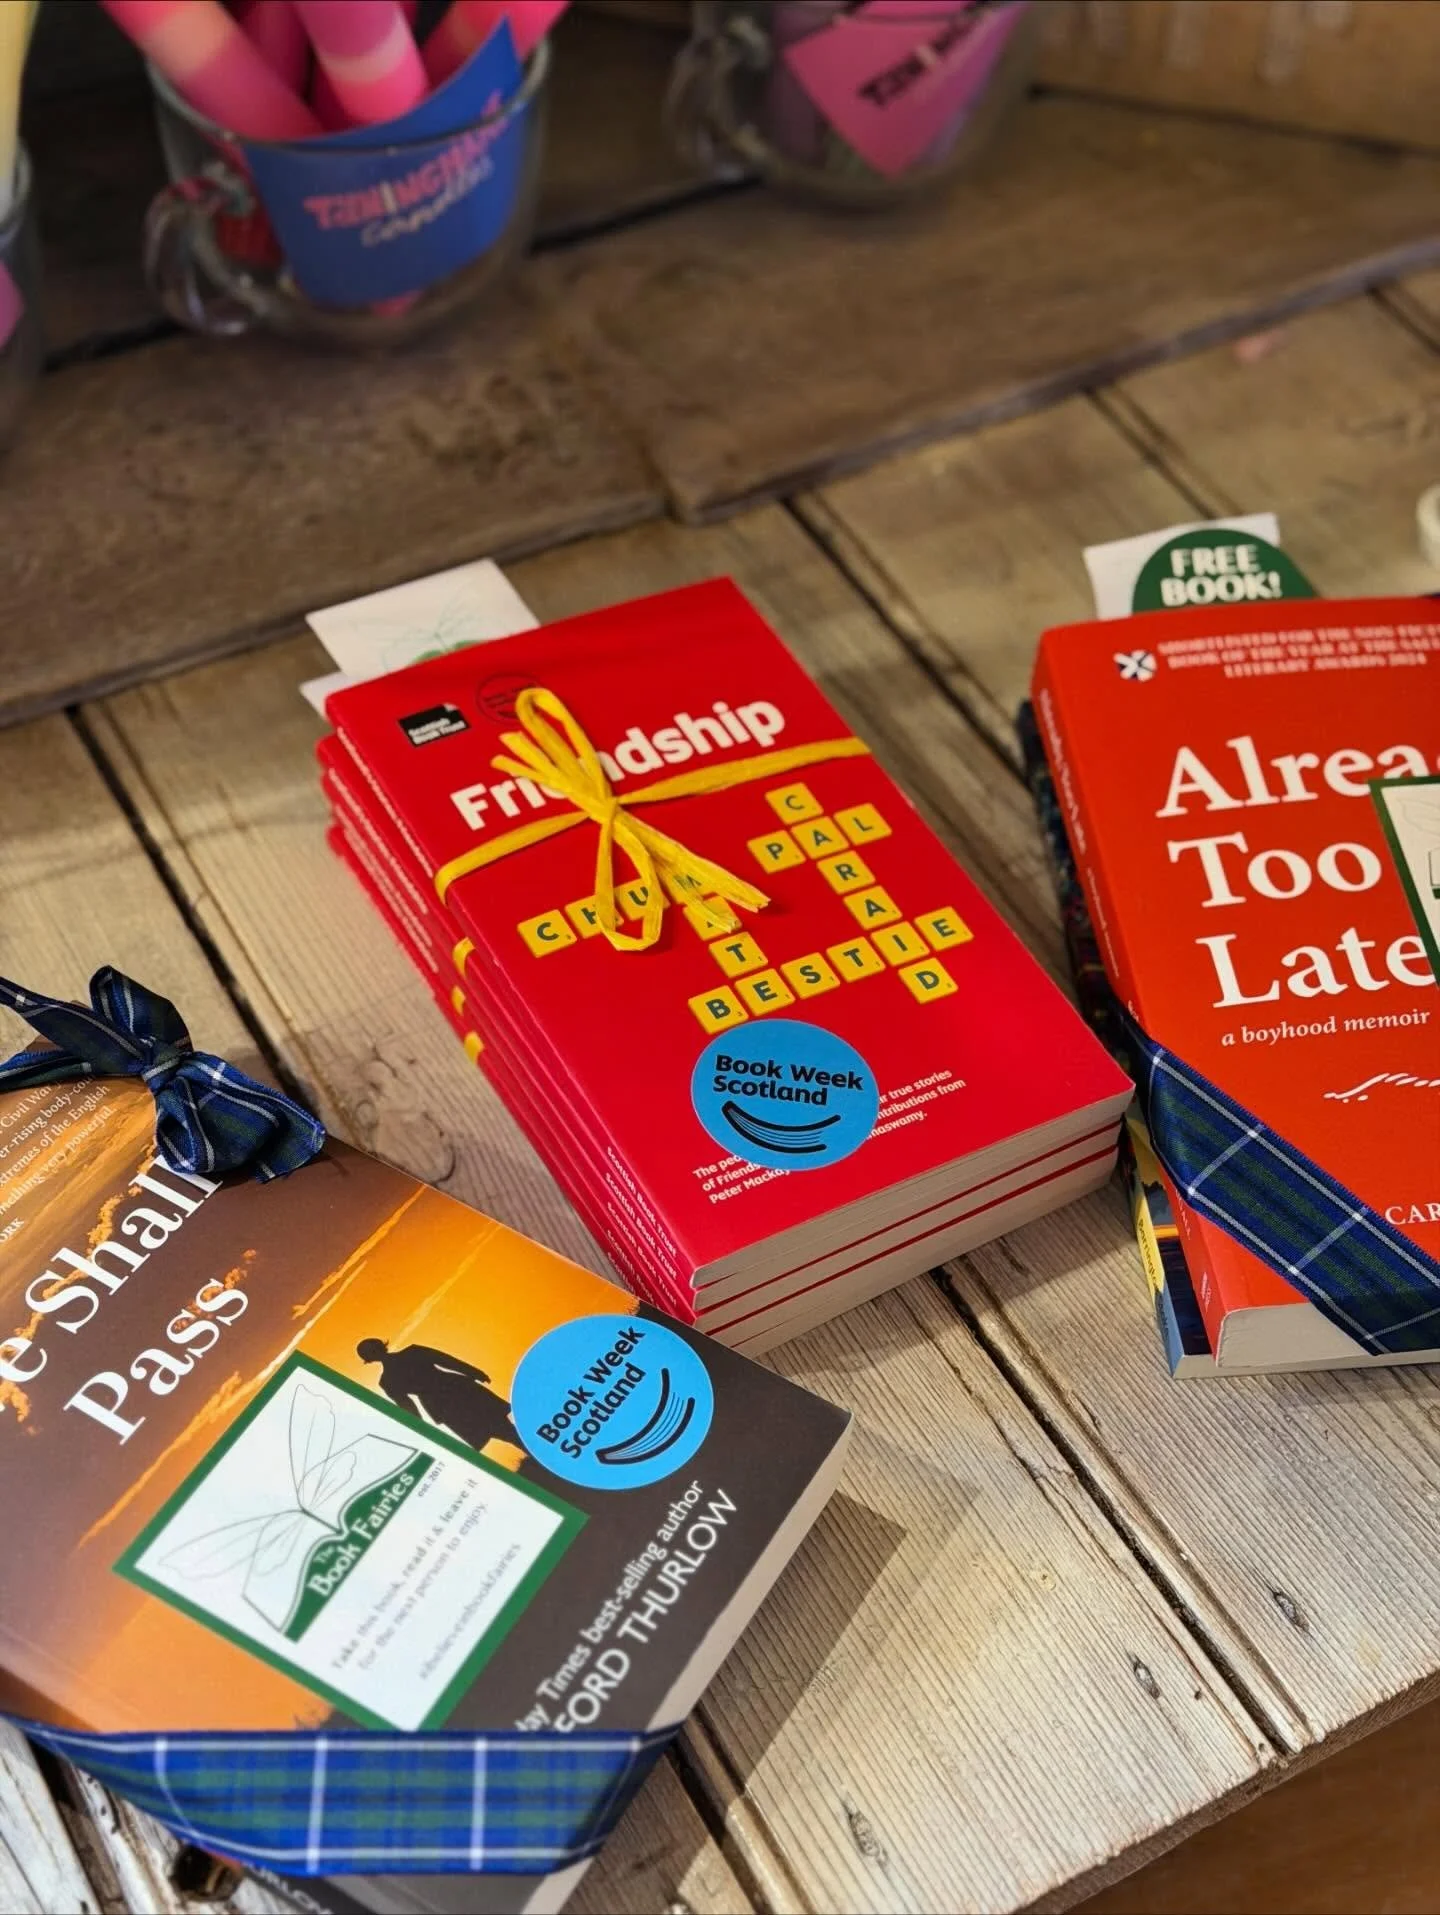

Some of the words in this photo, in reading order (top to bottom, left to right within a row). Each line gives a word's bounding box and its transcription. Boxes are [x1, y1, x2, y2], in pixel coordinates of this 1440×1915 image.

[1160, 570, 1283, 607] BOOK!
[1170, 543, 1262, 577] FREE
[450, 700, 785, 831] Frindship
[1156, 734, 1440, 818] Alrea
[1167, 831, 1383, 908] Too
[705, 916, 956, 1020] BESTIE
[1195, 926, 1437, 1009] Late
[1221, 1032, 1236, 1047] a
[1241, 1016, 1338, 1046] boyhood
[1343, 1008, 1432, 1033] memoir
[711, 1074, 828, 1107] Scotland
[715, 1053, 783, 1080] Book
[789, 1062, 865, 1092] Week
[888, 1084, 915, 1100] true
[912, 1069, 953, 1091] stories
[936, 1078, 967, 1096] from
[0, 1101, 30, 1128] Civil
[40, 1130, 56, 1149] of
[50, 1118, 73, 1140] the
[67, 1084, 111, 1121] English
[65, 1105, 118, 1155] powerful.
[692, 1162, 718, 1179] The
[702, 1178, 717, 1192] of
[708, 1183, 743, 1205] Peter
[25, 1154, 223, 1335] Shall
[605, 1171, 636, 1219] Scottish
[635, 1215, 656, 1250] Book
[656, 1245, 677, 1280] Trust
[62, 1278, 249, 1446] Pass
[534, 1382, 596, 1446] Book
[582, 1324, 647, 1390] Week
[559, 1361, 647, 1461] Scotland
[306, 1541, 362, 1599] Book
[350, 1471, 415, 1542] Fairies
[400, 1544, 428, 1579] read
[423, 1534, 437, 1549] it
[431, 1524, 445, 1538] &
[438, 1490, 471, 1525] leave
[466, 1476, 479, 1490] it
[444, 1534, 462, 1552] to
[535, 1642, 593, 1701] Times
[579, 1540, 668, 1644] best-selling
[656, 1479, 705, 1544] author
[615, 1487, 738, 1644] THURLOW
